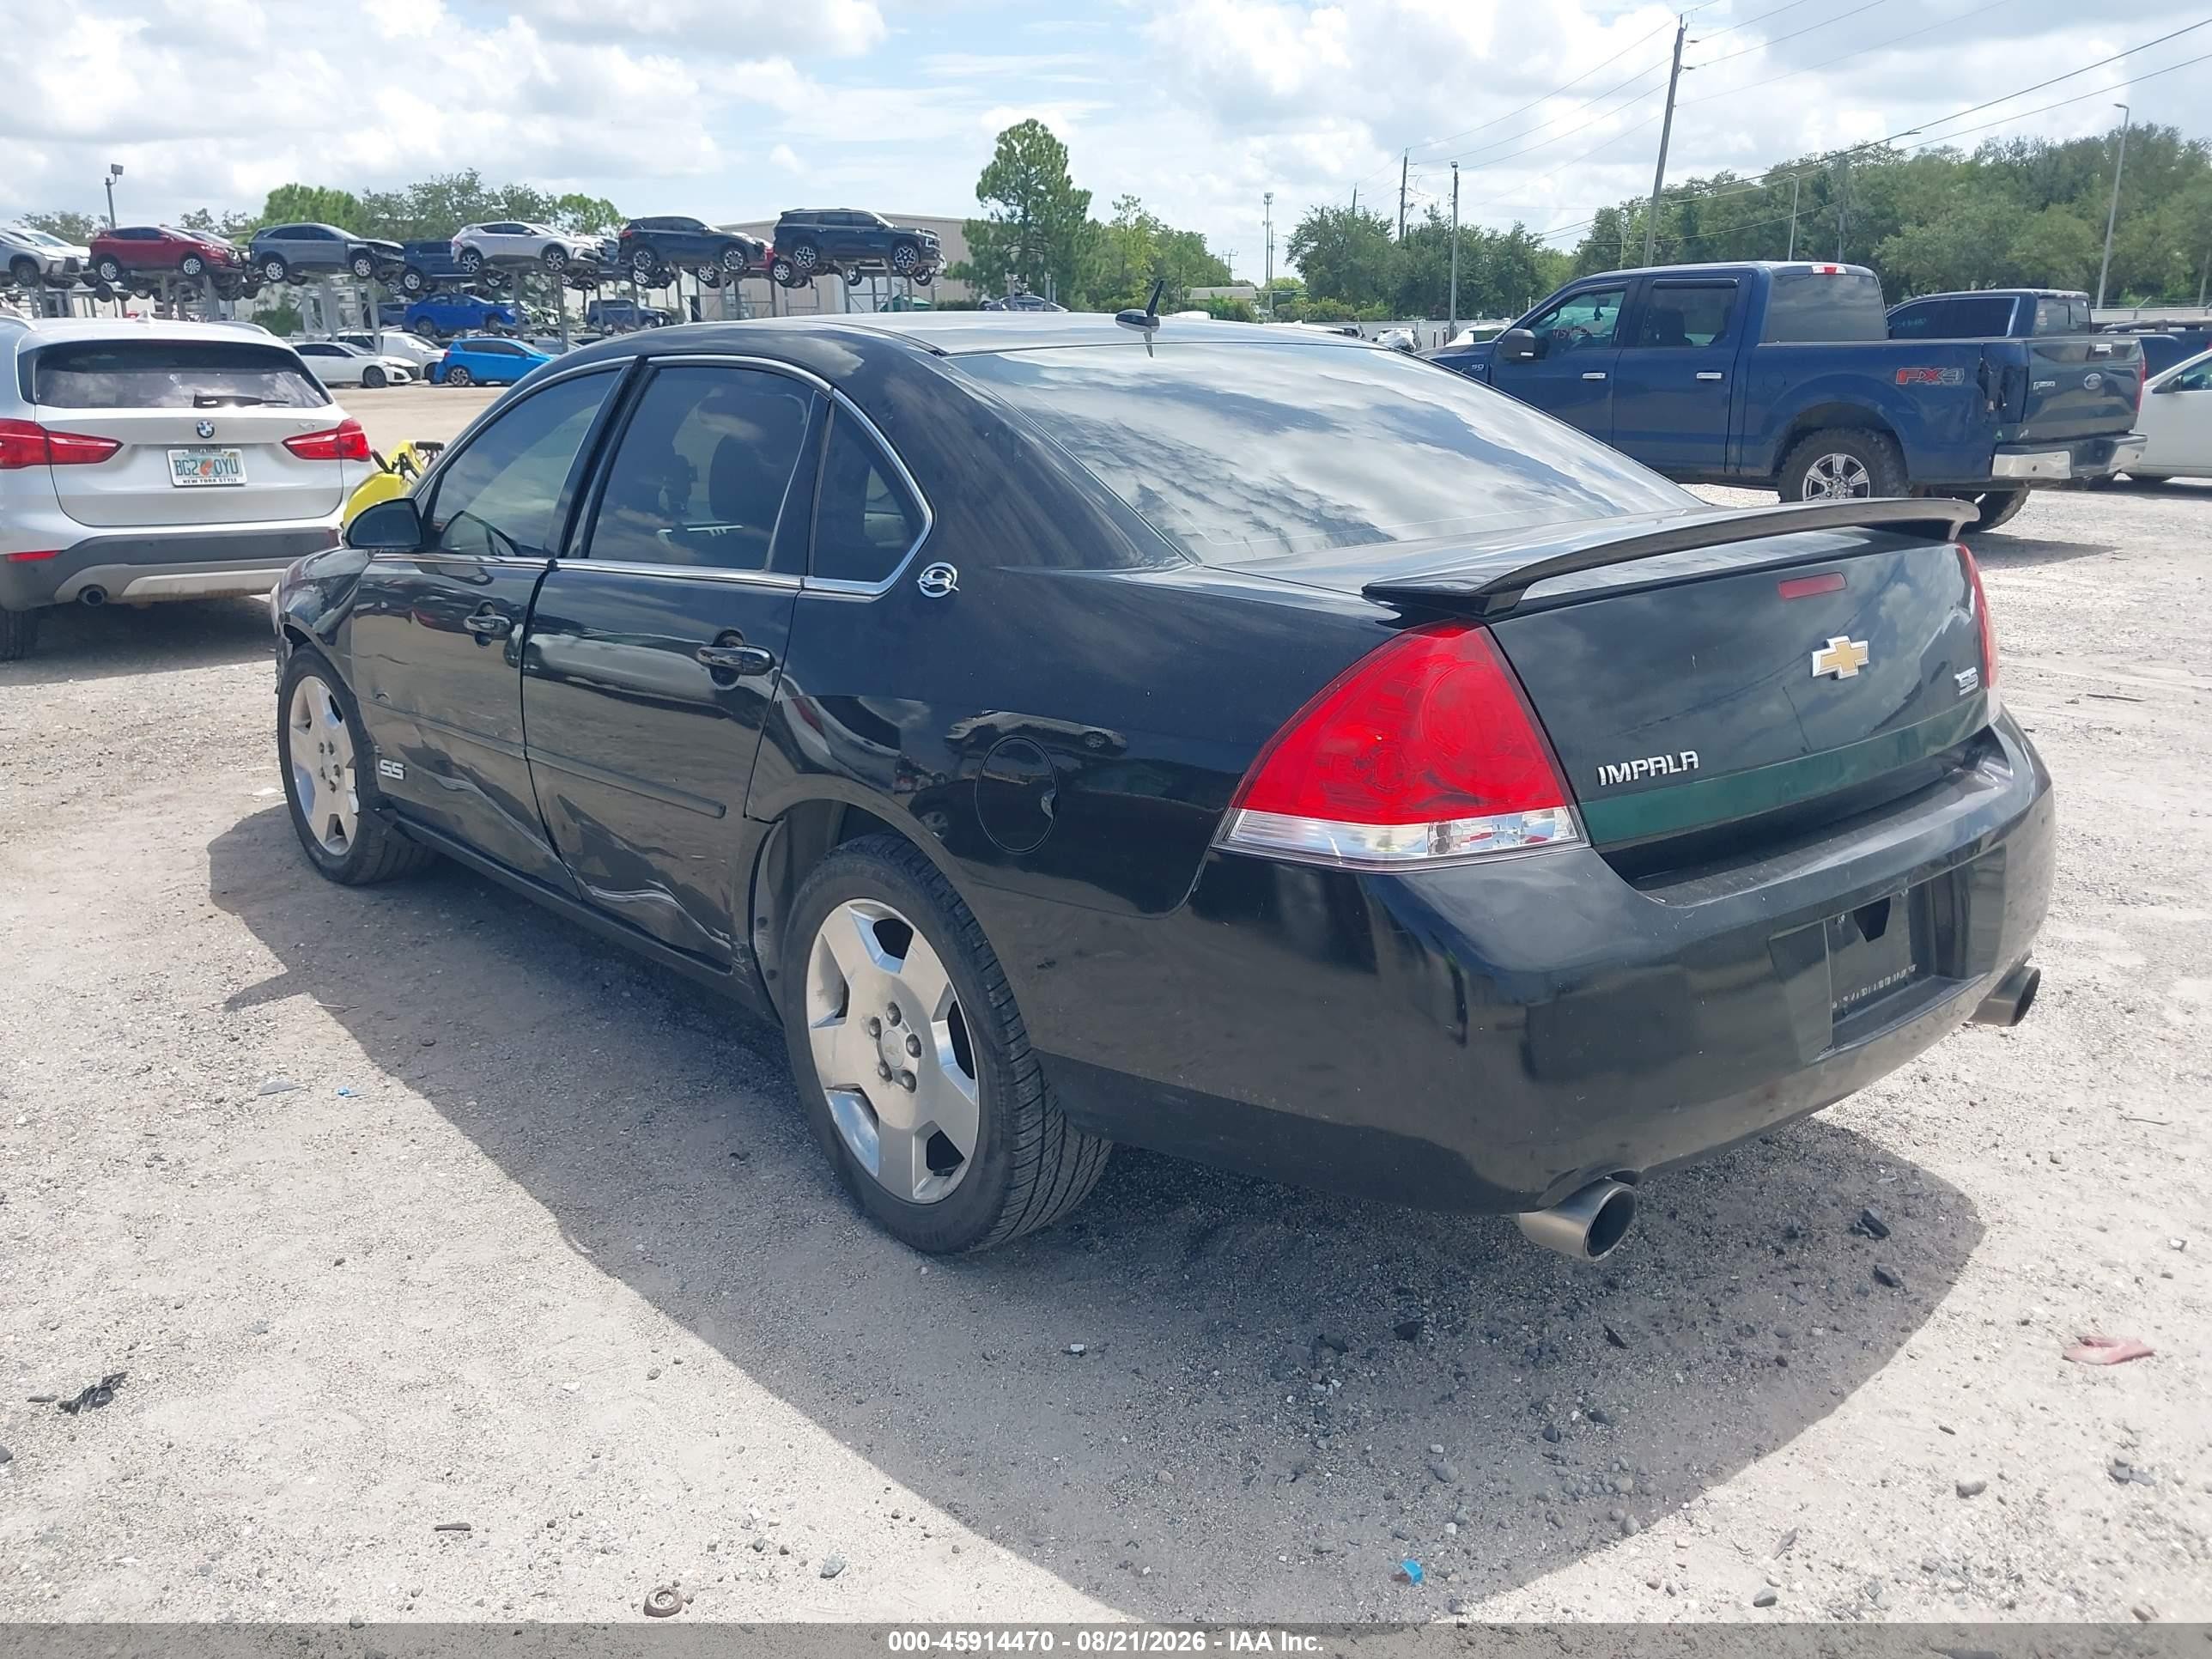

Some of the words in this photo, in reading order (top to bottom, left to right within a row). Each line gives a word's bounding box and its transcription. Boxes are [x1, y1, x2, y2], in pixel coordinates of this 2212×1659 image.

[1896, 368, 1965, 385] FX4
[1954, 666, 1978, 696] SS
[380, 759, 404, 781] SS
[1597, 750, 1699, 787] IMPALA
